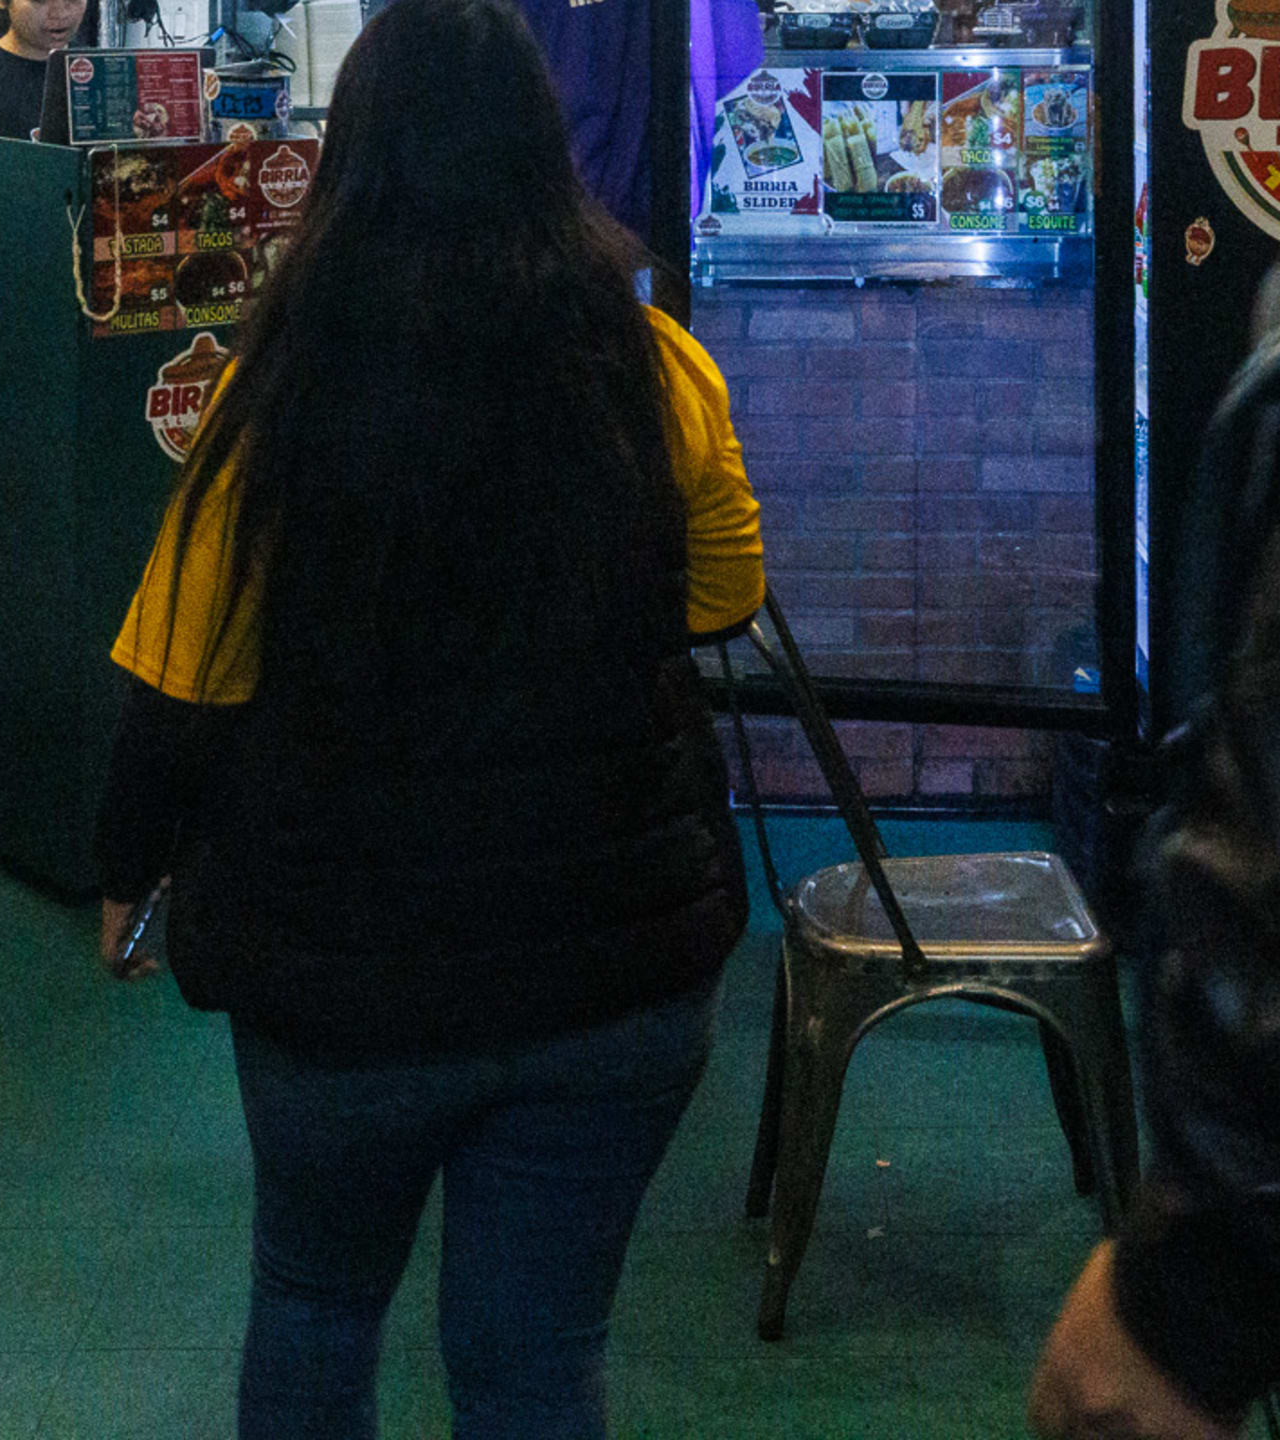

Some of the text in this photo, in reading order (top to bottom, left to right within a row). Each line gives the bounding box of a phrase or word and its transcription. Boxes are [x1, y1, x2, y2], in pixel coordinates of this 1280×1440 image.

[992, 132, 1012, 145] $4
[961, 149, 994, 163] TACO
[261, 168, 309, 185] BIRRIA
[743, 181, 798, 192] BIRRIA
[1025, 195, 1045, 208] $6
[229, 207, 246, 220] $4
[912, 203, 925, 218] $5
[152, 214, 169, 227] $4
[1029, 215, 1076, 230] ESQUITE
[109, 236, 164, 257] TSTADA
[198, 231, 233, 249] TACOS
[151, 288, 168, 301] $5
[229, 281, 245, 294] $6
[111, 312, 160, 329] MULITAS
[149, 385, 201, 418] BIR
